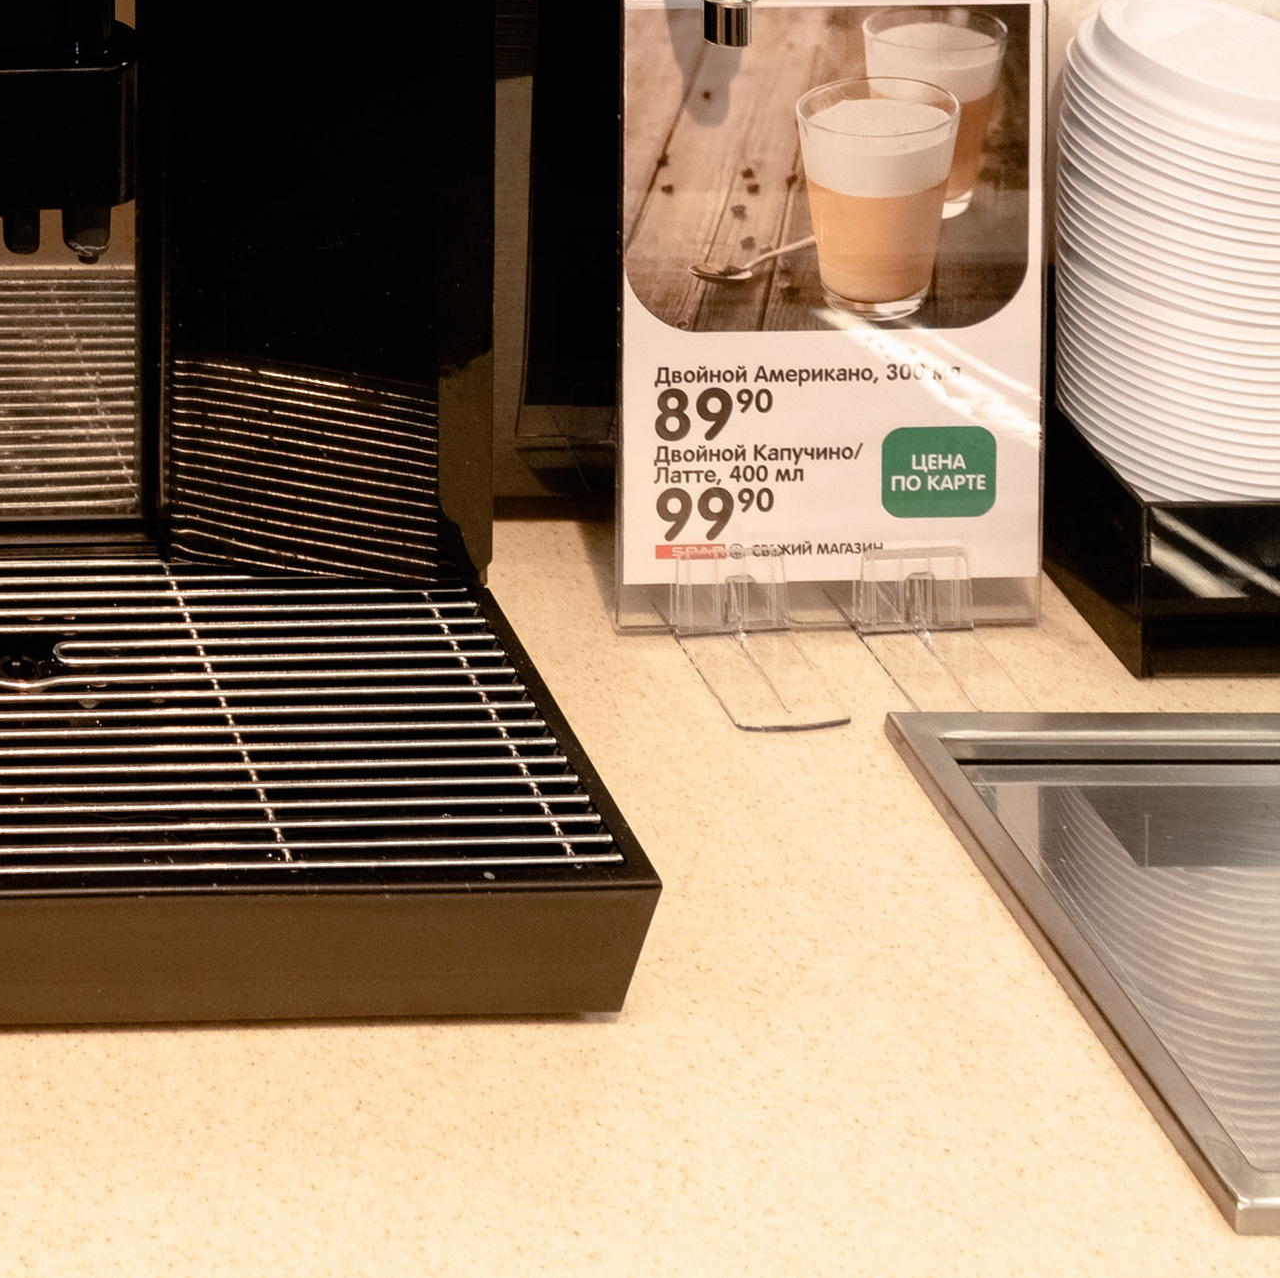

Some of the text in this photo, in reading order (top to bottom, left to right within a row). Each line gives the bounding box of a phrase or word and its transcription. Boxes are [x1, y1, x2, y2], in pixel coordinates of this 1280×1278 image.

[654, 365, 747, 387] Двойной
[754, 364, 879, 385] Американо,
[654, 387, 733, 442] 89
[654, 442, 863, 466] Двойной Капучино/
[911, 453, 966, 472] ЦЕНА
[654, 465, 804, 485] Латте, 400 мл
[891, 473, 986, 492] ПО КАРТЕ
[655, 487, 734, 542] 99
